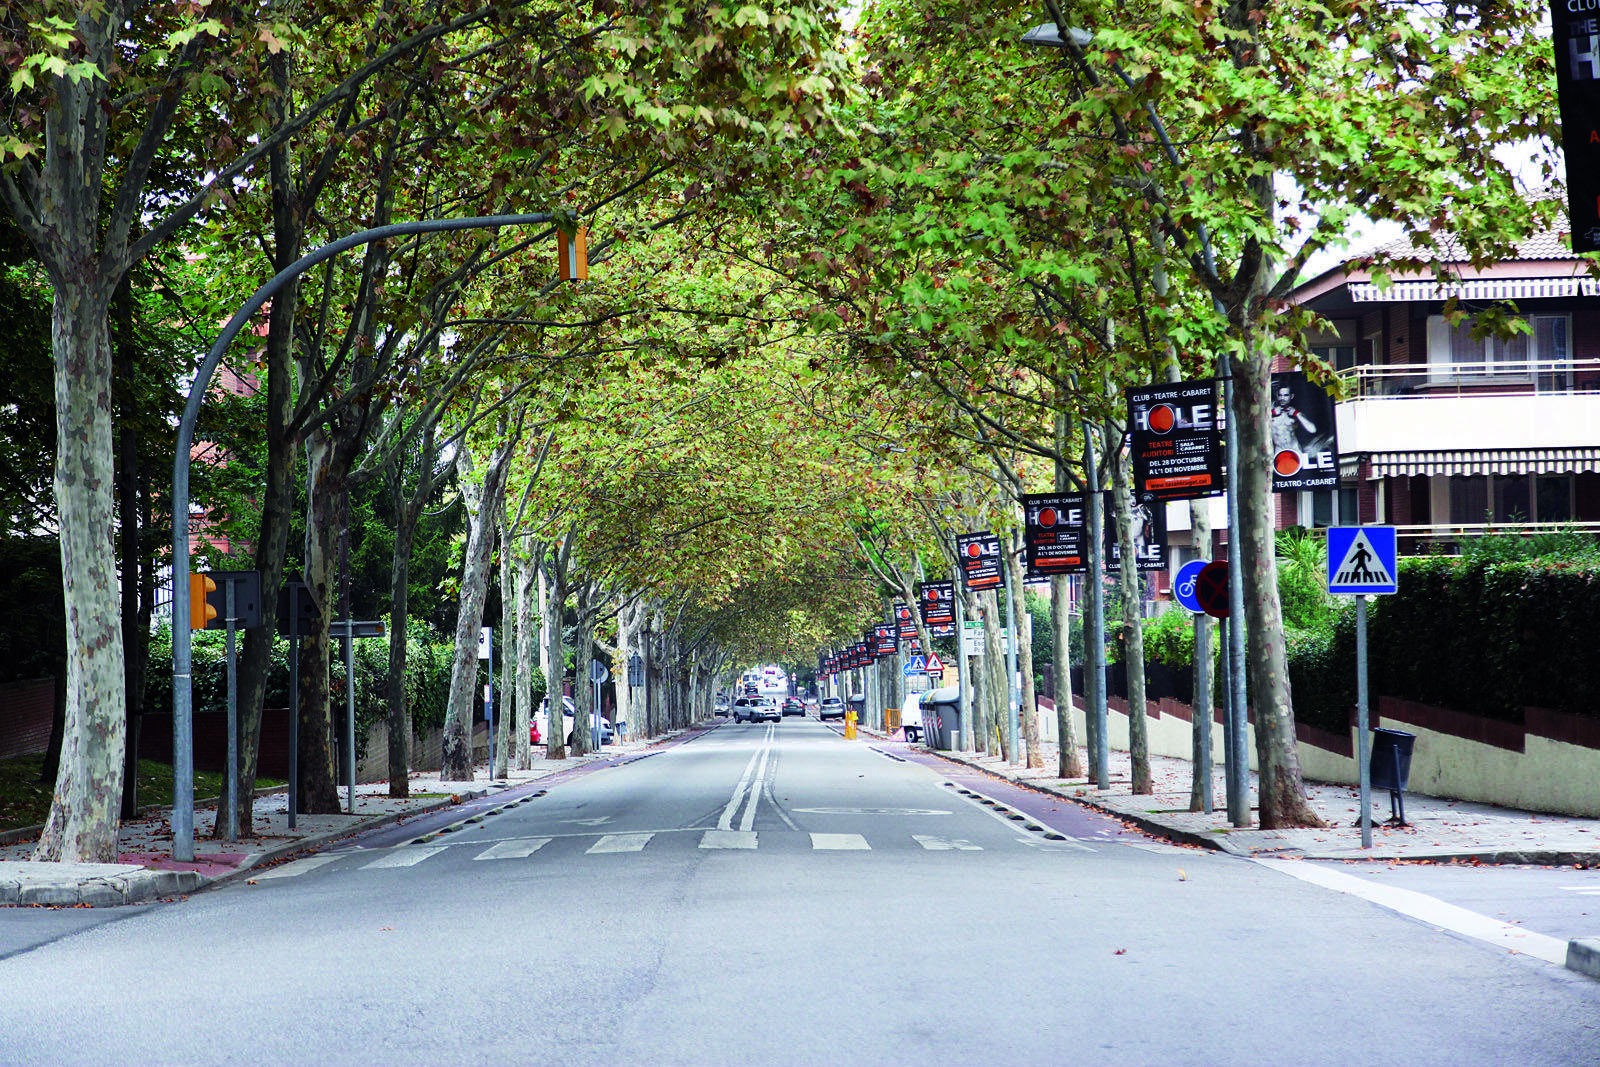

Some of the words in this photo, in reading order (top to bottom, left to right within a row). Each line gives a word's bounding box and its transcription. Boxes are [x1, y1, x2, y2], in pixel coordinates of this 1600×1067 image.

[1567, 0, 1600, 12] CLU
[1154, 392, 1178, 400] TEATRE
[1182, 388, 1211, 397] CABARET
[1134, 402, 1212, 434] HOLE
[1148, 440, 1173, 448] TEATRE
[1142, 450, 1174, 458] AUDITORI
[1171, 456, 1204, 465] D'OCTUBRE
[1174, 464, 1208, 473] NOVEMBRE
[1306, 478, 1336, 486] CABARET
[1029, 507, 1082, 528] HOLE
[960, 542, 999, 558] HOLE
[922, 589, 953, 601] HOLE
